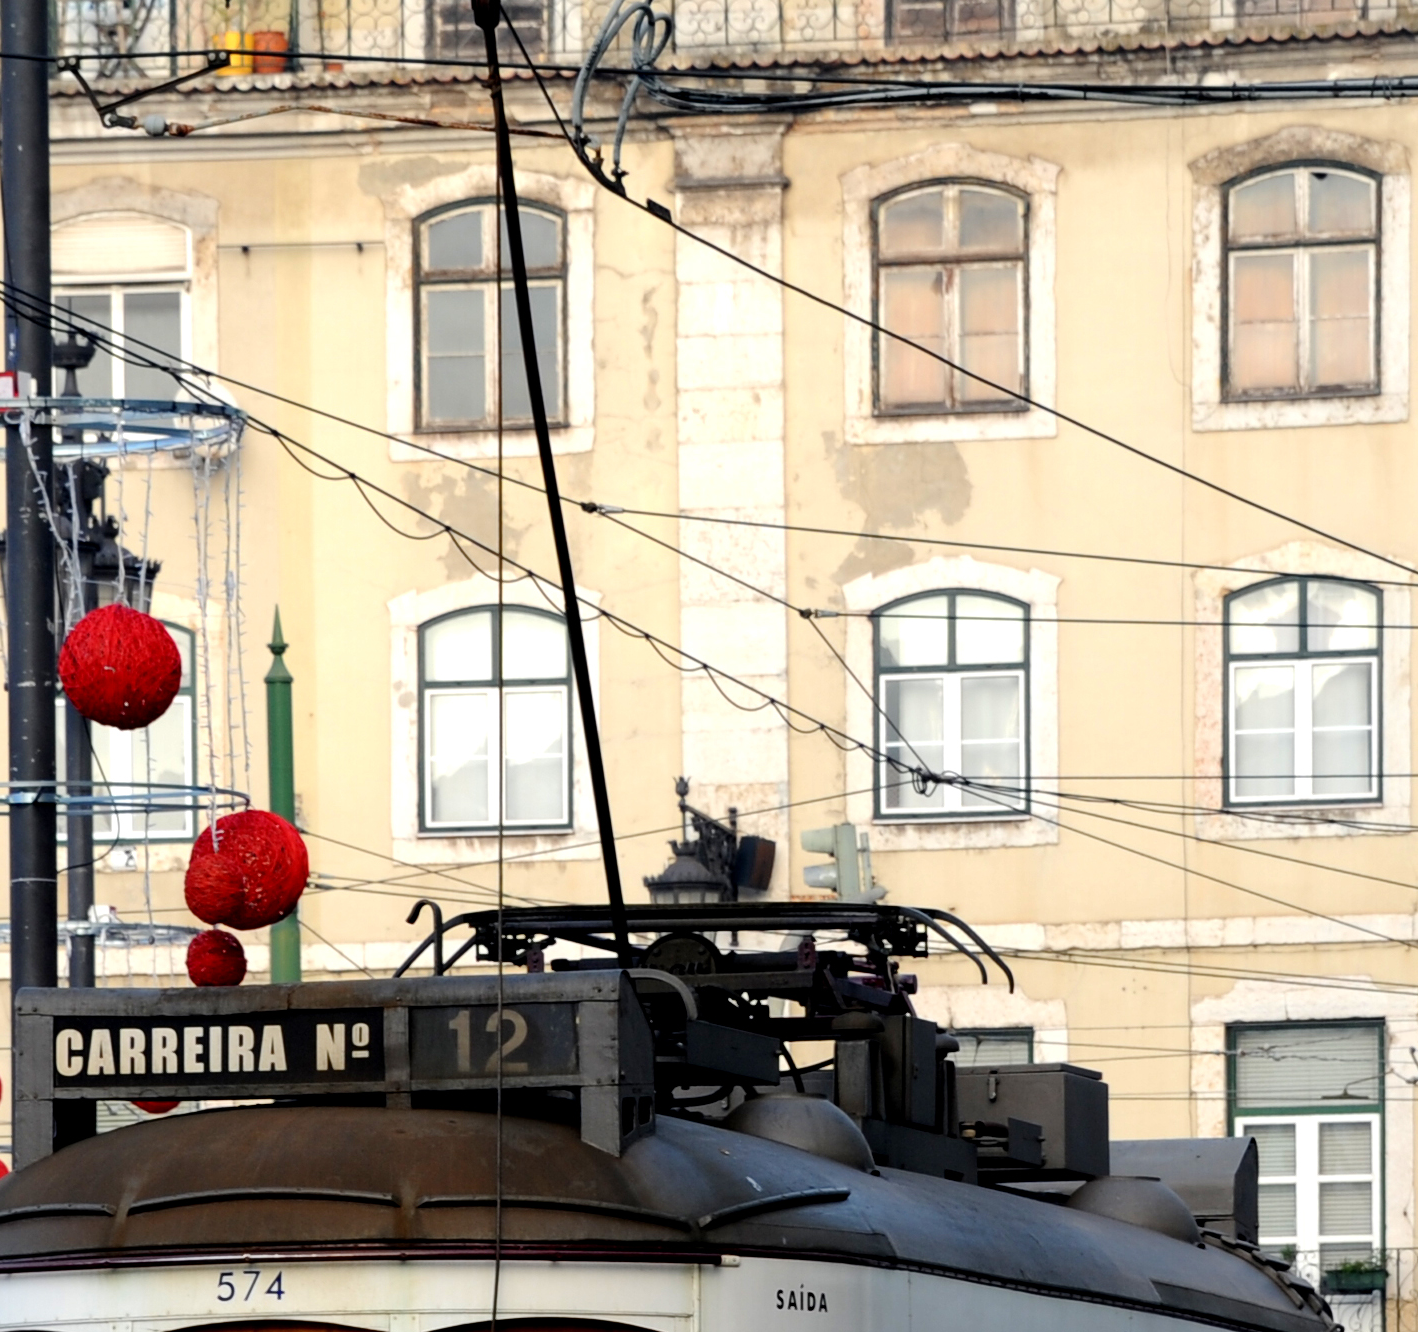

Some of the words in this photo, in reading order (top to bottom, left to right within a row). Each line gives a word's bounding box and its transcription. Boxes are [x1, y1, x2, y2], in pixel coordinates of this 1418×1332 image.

[55, 1023, 287, 1077] CARREIRA
[315, 1022, 370, 1072] Nº
[448, 1009, 530, 1073] 12
[216, 1271, 285, 1301] 574
[776, 1283, 828, 1313] SAÍDA
